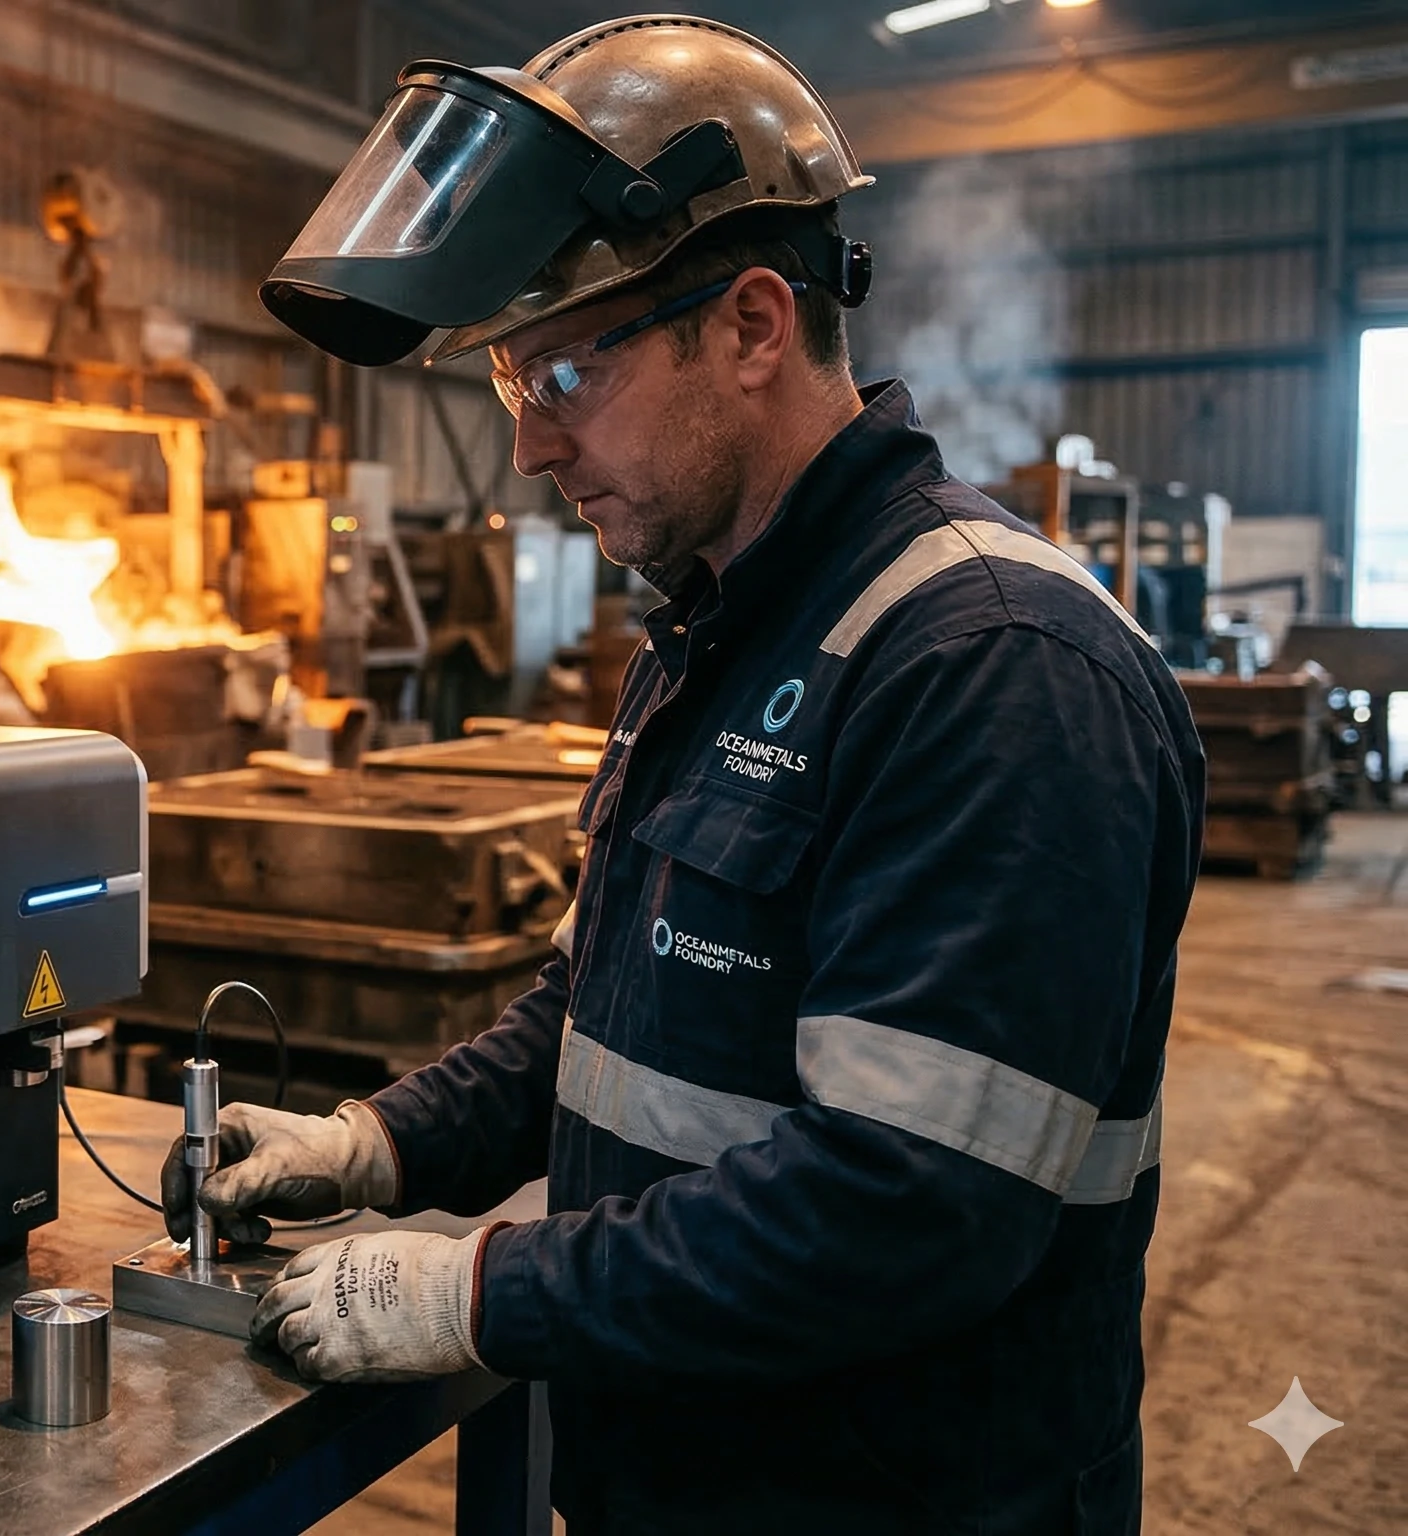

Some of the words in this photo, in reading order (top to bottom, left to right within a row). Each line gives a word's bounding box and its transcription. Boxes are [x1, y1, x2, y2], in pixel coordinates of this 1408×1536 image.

[716, 731, 807, 771] OCEANMETALS
[723, 755, 778, 783] FOUNDRY
[675, 932, 771, 970] OCEANMETALS
[675, 946, 732, 974] FOUNDRY
